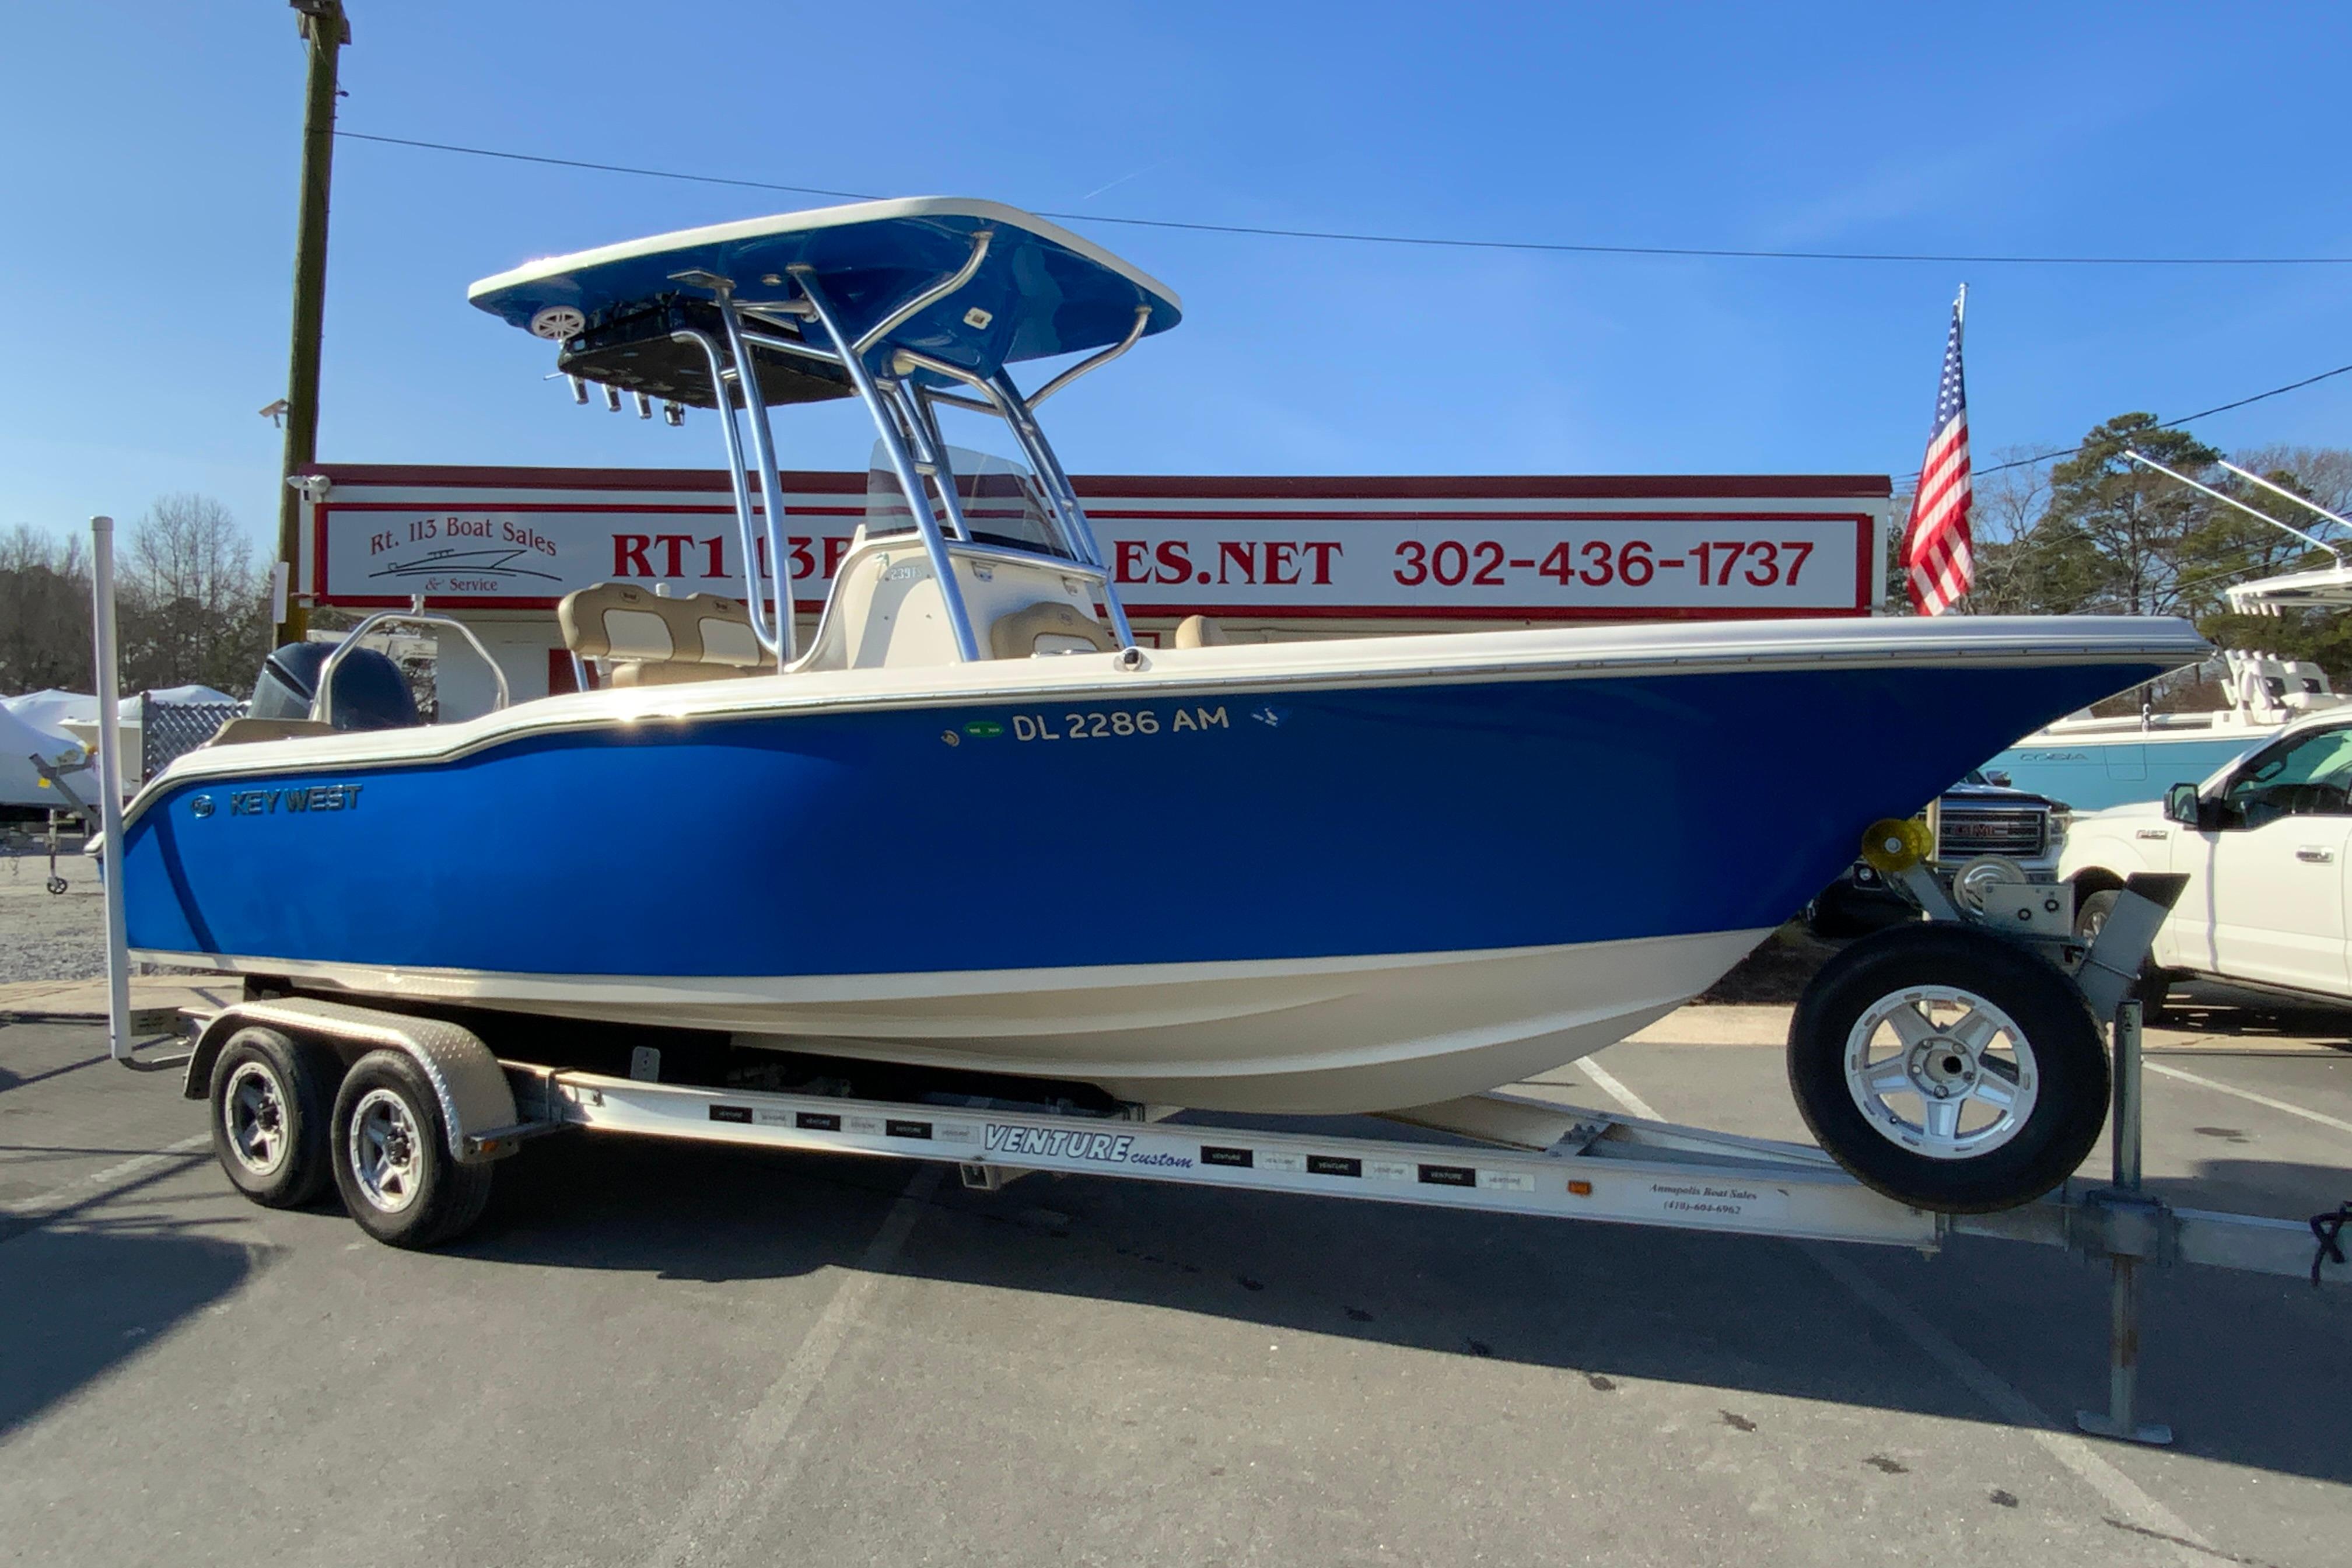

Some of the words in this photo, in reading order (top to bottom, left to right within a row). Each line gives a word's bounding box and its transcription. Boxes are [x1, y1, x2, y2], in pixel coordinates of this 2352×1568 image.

[371, 530, 399, 555] Rt.
[410, 519, 437, 542] 113
[447, 517, 493, 538] Boat
[503, 522, 557, 556] Sales
[1393, 540, 1814, 587] 302-436-1737
[450, 578, 498, 591] Service
[1013, 715, 1059, 741] DL
[1065, 710, 1160, 738] 2286
[1172, 705, 1230, 733] AM
[231, 790, 280, 816] KEY
[284, 784, 363, 813] WEST
[985, 1124, 1135, 1163] VENTURE
[1130, 1152, 1193, 1168] custom
[1650, 1184, 1701, 1196] Annapolis
[1703, 1187, 1728, 1197] Boat
[1730, 1189, 1757, 1200] Sales
